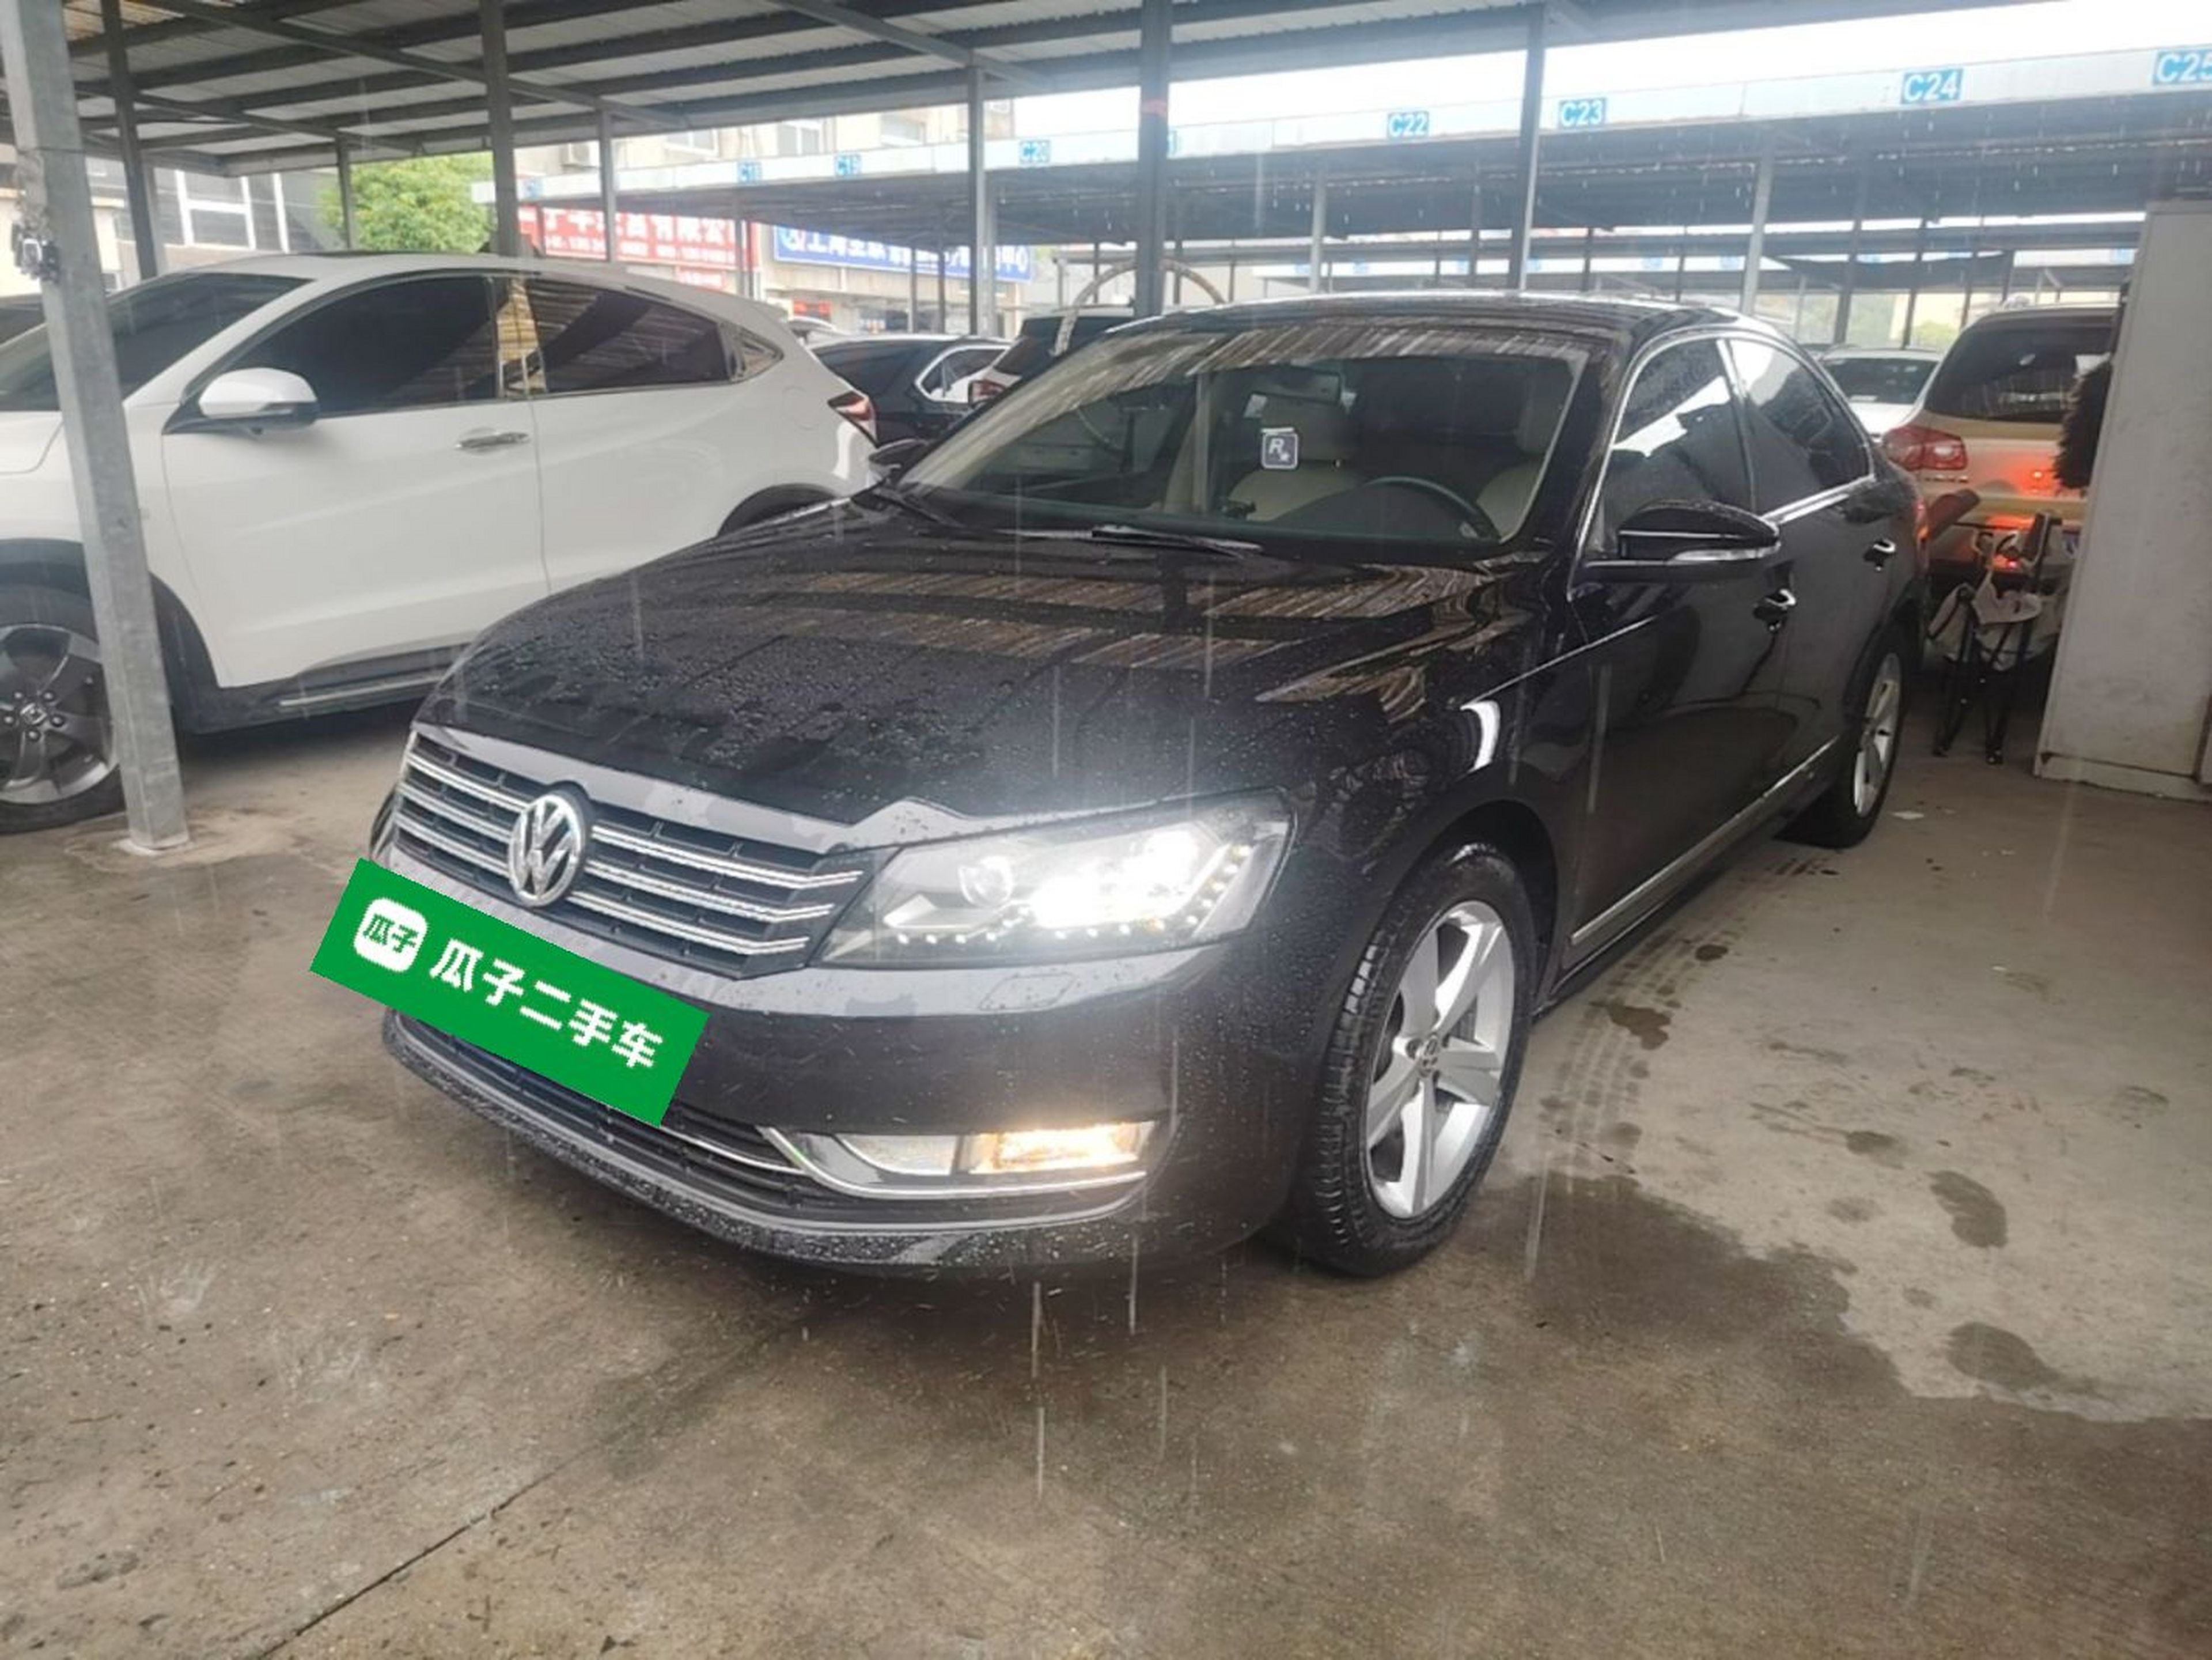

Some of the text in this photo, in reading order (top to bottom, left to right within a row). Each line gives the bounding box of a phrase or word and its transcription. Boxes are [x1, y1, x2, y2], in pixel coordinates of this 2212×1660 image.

[1904, 70, 1957, 102] C24
[1388, 113, 1428, 137] C22
[1560, 100, 1604, 127] C23
[1022, 140, 1049, 162] C20
